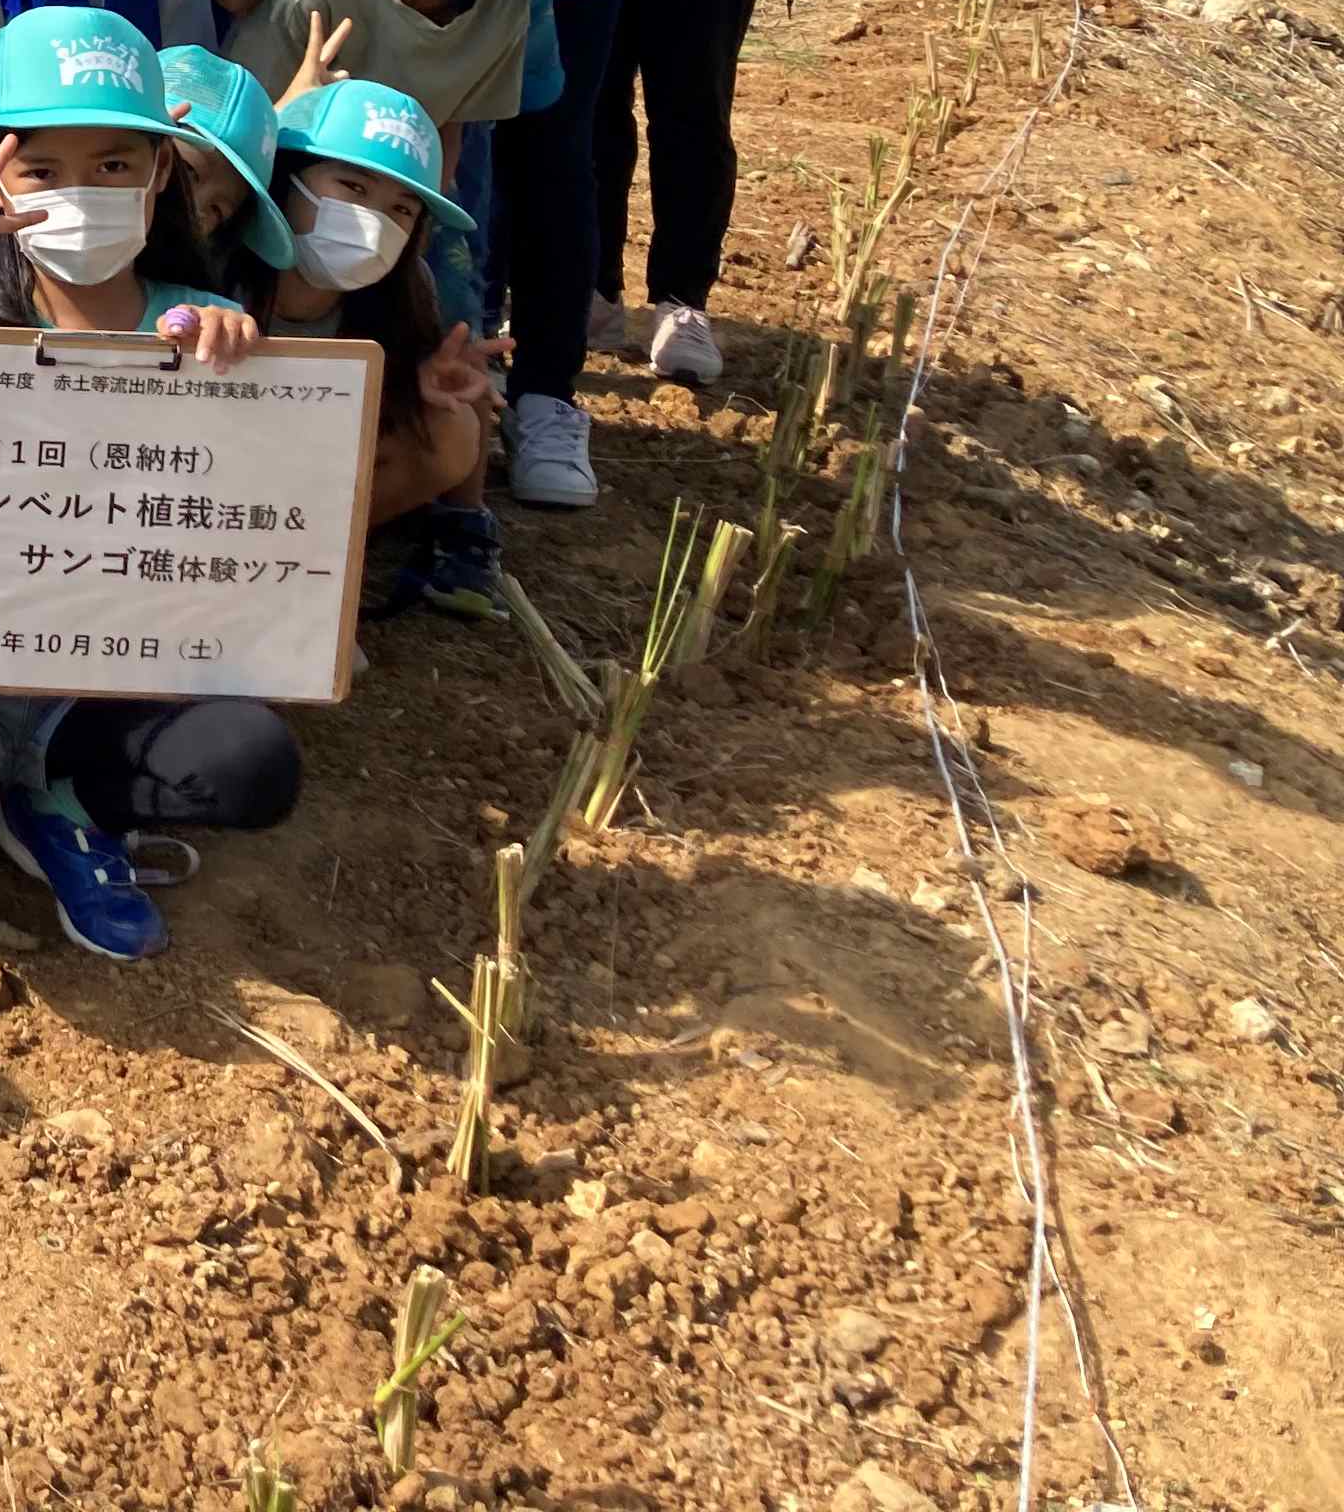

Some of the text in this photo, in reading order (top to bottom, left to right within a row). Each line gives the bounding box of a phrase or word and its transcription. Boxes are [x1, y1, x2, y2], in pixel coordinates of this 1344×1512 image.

[20, 543, 333, 585] サンゴ礁体験ツアー
